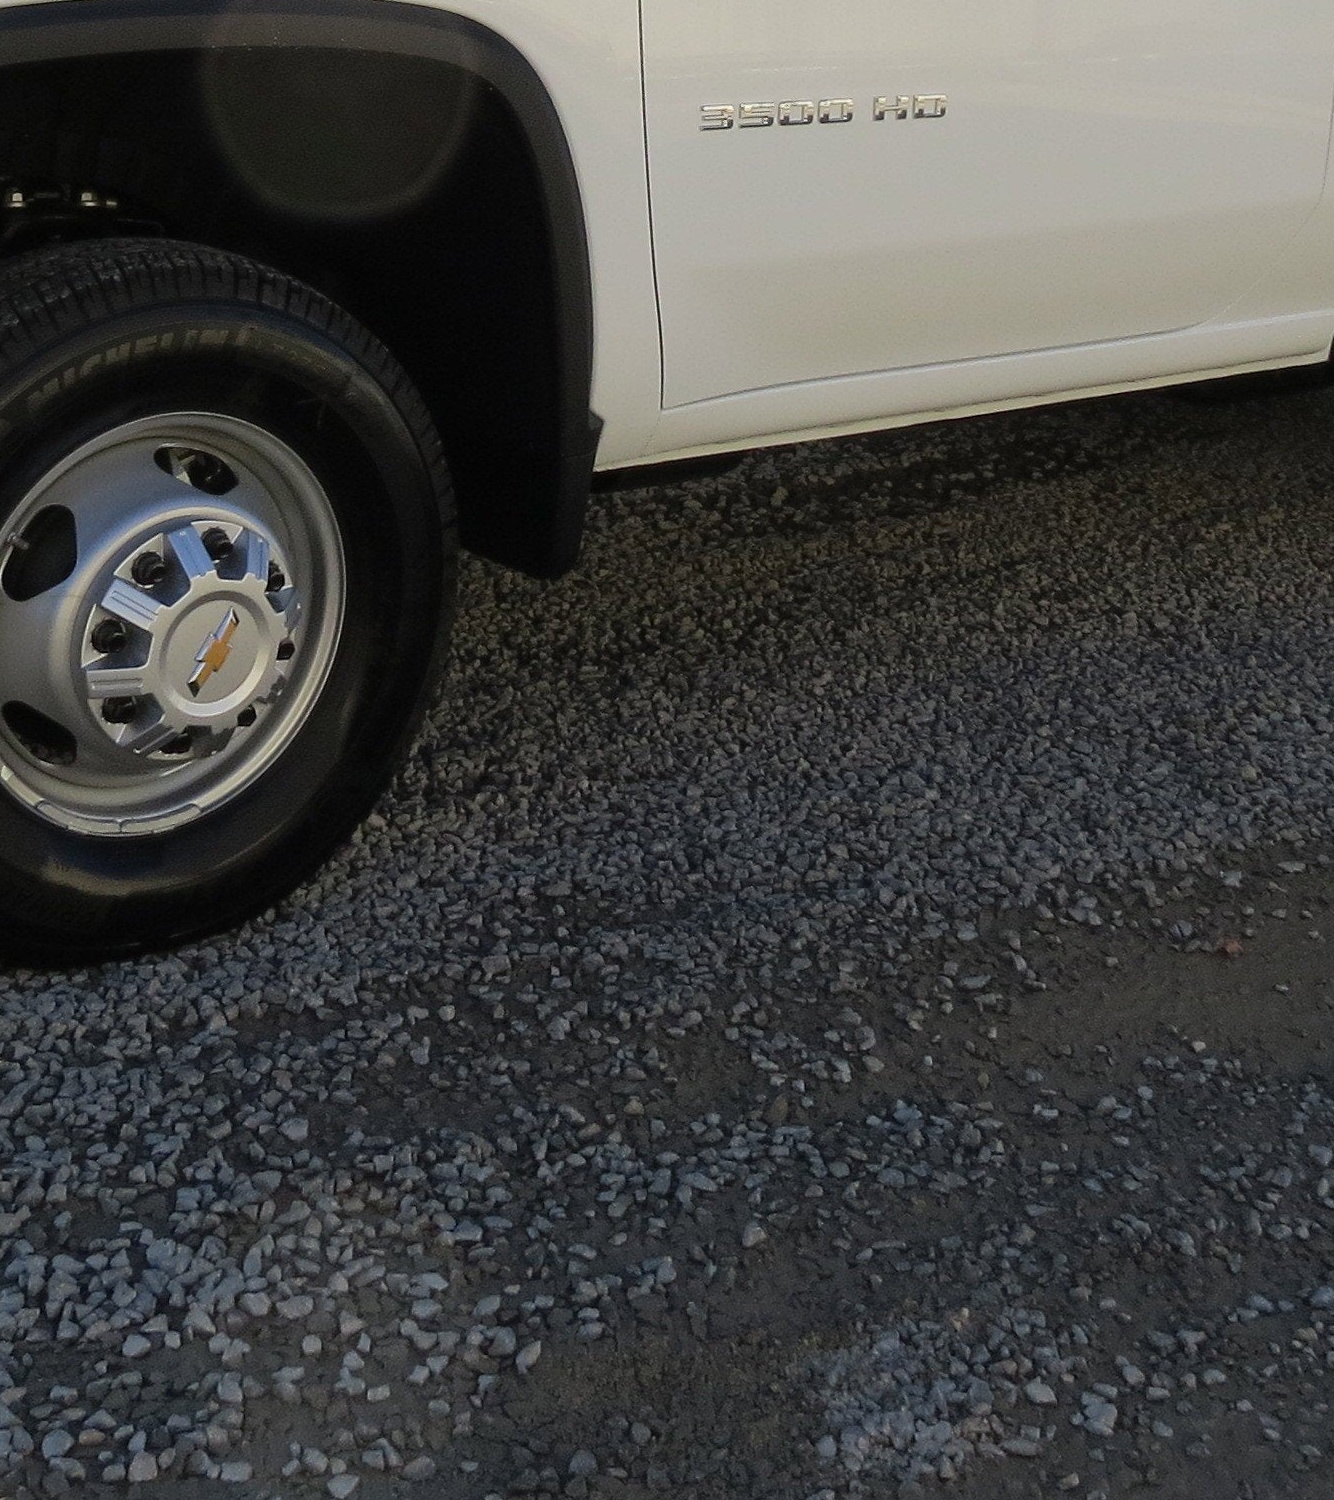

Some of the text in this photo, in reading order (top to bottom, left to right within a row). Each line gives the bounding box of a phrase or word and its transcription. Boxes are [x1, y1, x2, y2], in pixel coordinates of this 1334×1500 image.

[699, 93, 947, 131] 3500 HD
[27, 329, 230, 410] MICHELIN
